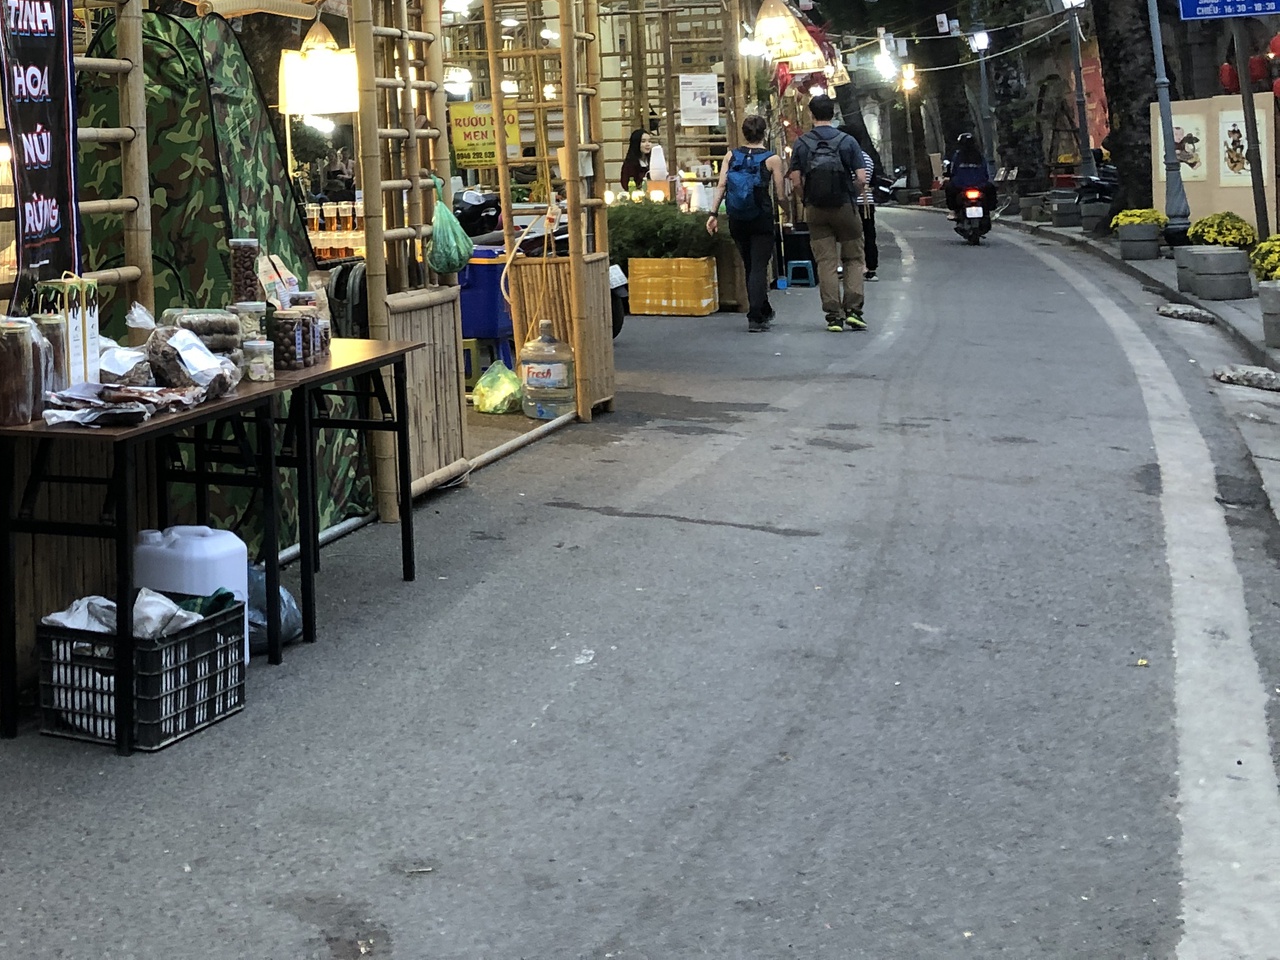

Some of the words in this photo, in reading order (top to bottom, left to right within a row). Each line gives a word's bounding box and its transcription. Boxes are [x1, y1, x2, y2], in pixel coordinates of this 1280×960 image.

[1196, 4, 1221, 16] CHIỀU:
[13, 65, 50, 101] HOA
[21, 123, 51, 168] NÚI
[463, 130, 488, 141] MEN
[24, 192, 61, 238] RỪNG
[527, 366, 551, 379] Fresh
